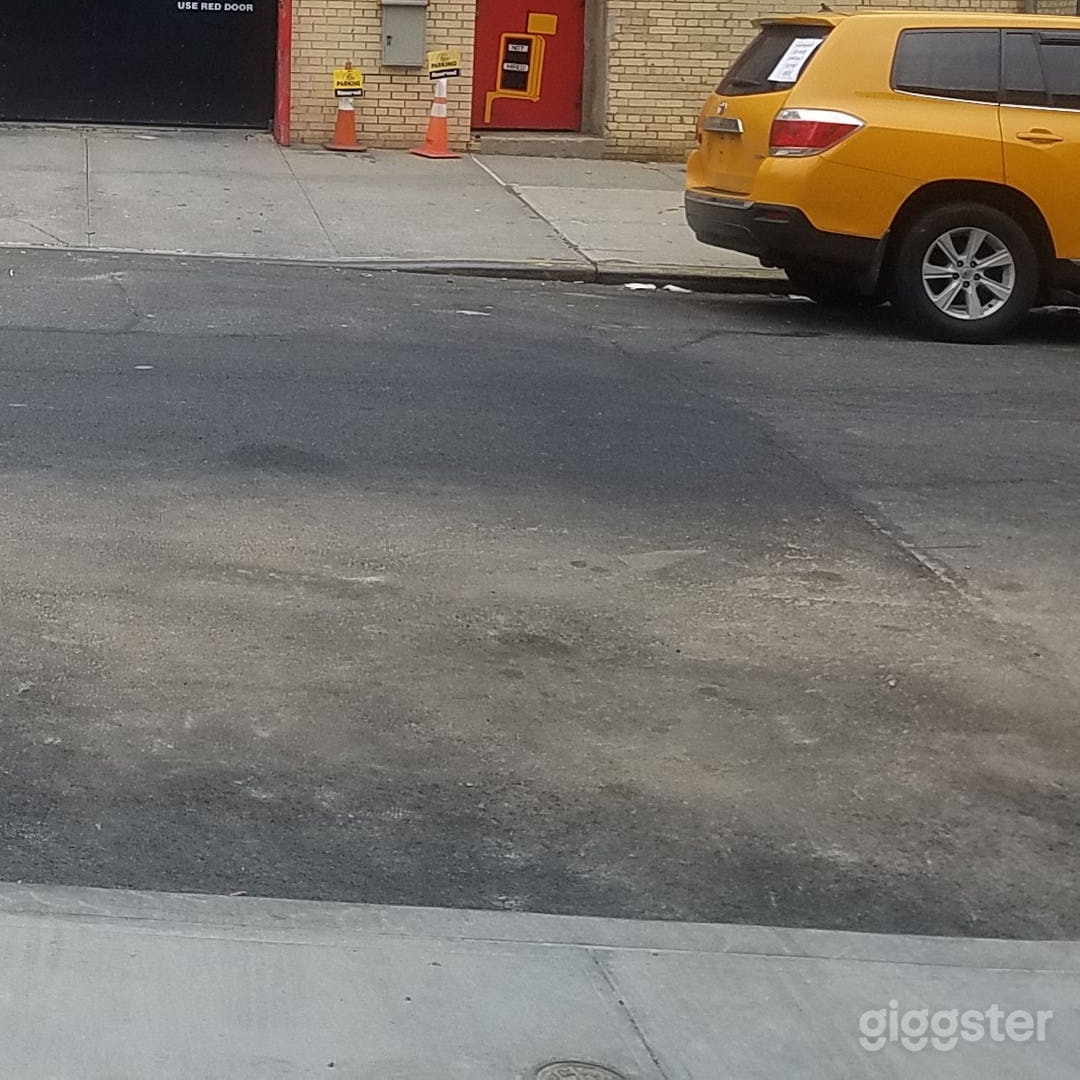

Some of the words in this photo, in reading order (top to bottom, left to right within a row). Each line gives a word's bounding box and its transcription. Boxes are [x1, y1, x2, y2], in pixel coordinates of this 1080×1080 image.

[177, 1, 198, 10] USE
[201, 2, 221, 11] RED
[224, 3, 253, 12] DOOR
